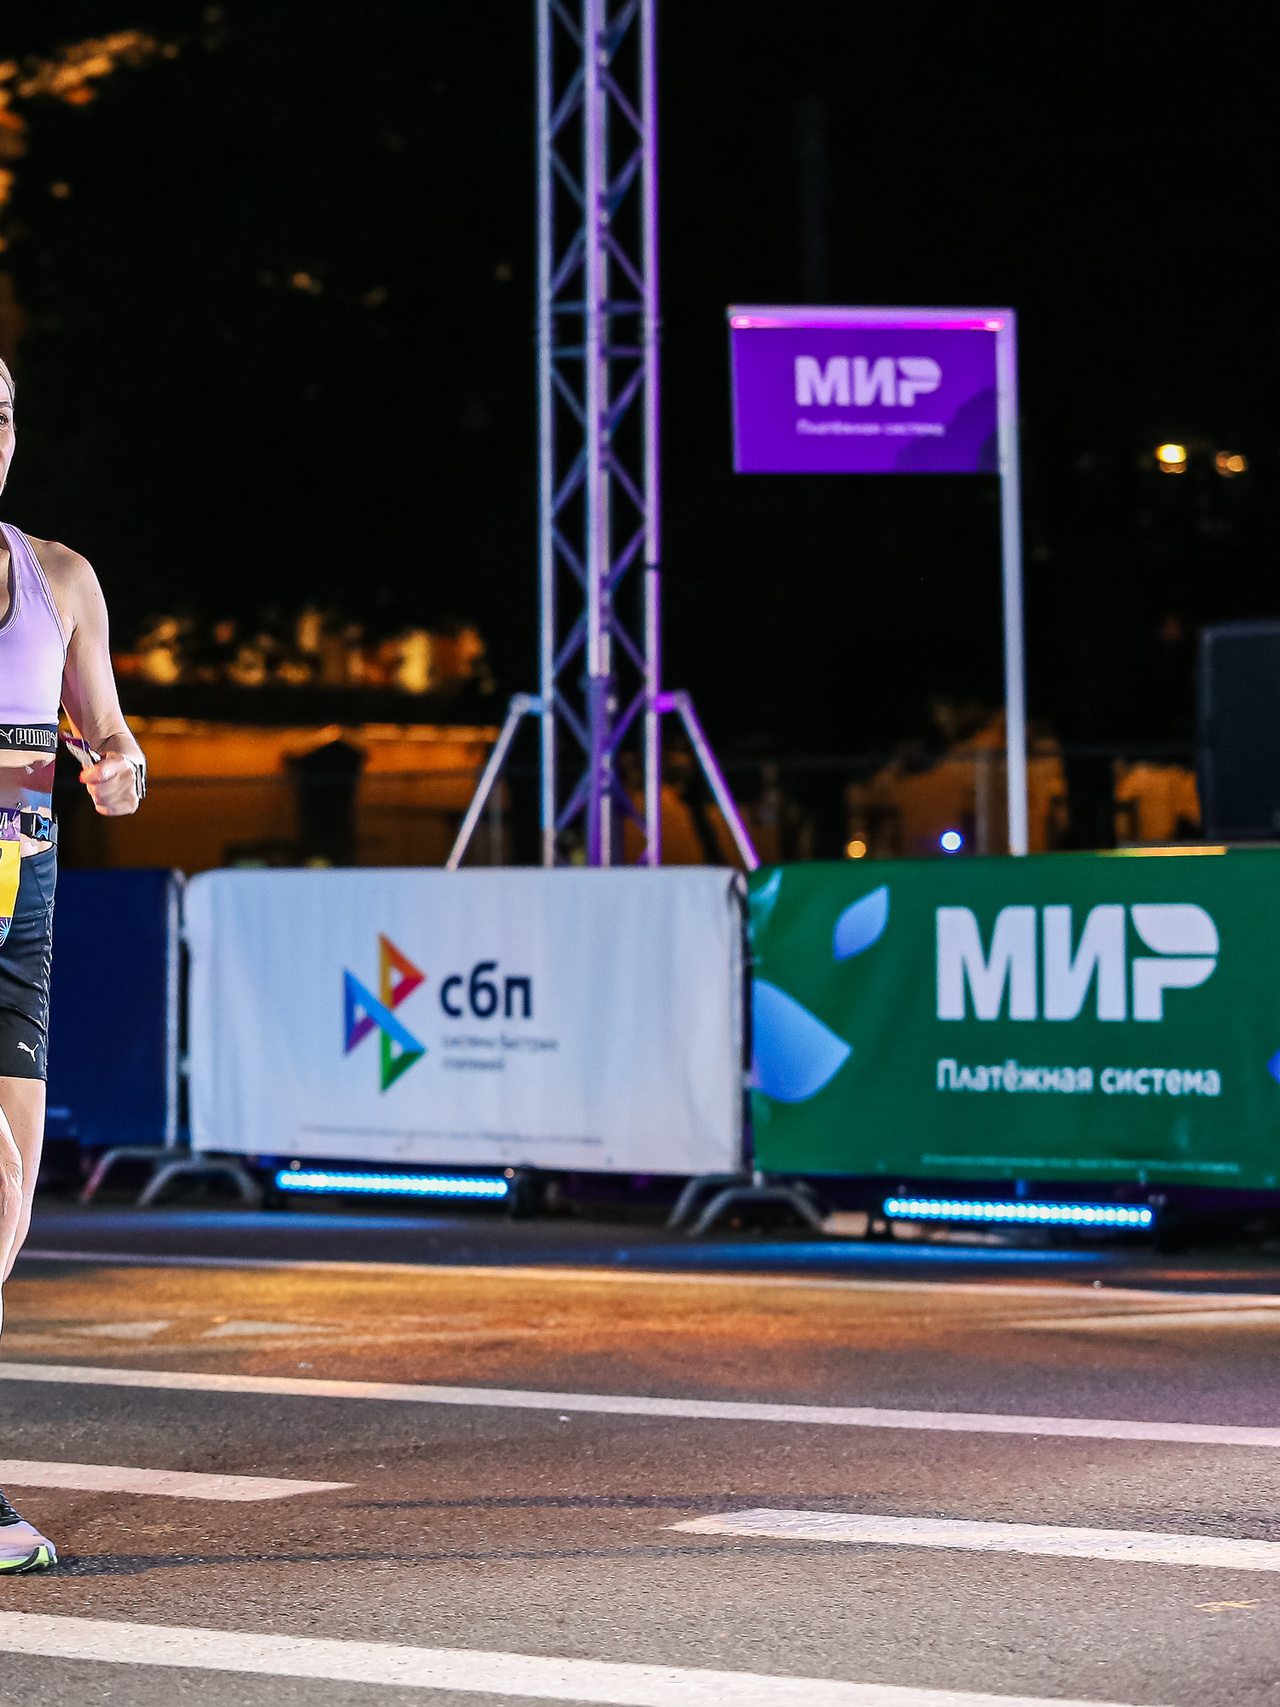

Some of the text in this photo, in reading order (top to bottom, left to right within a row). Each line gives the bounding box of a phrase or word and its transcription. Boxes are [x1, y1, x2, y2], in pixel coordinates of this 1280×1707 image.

[795, 355, 942, 407] МИР
[15, 727, 51, 747] PUMA
[936, 903, 1219, 1021] МИР
[439, 961, 532, 1019] сбп
[937, 1058, 1221, 1096] Платёжная система
